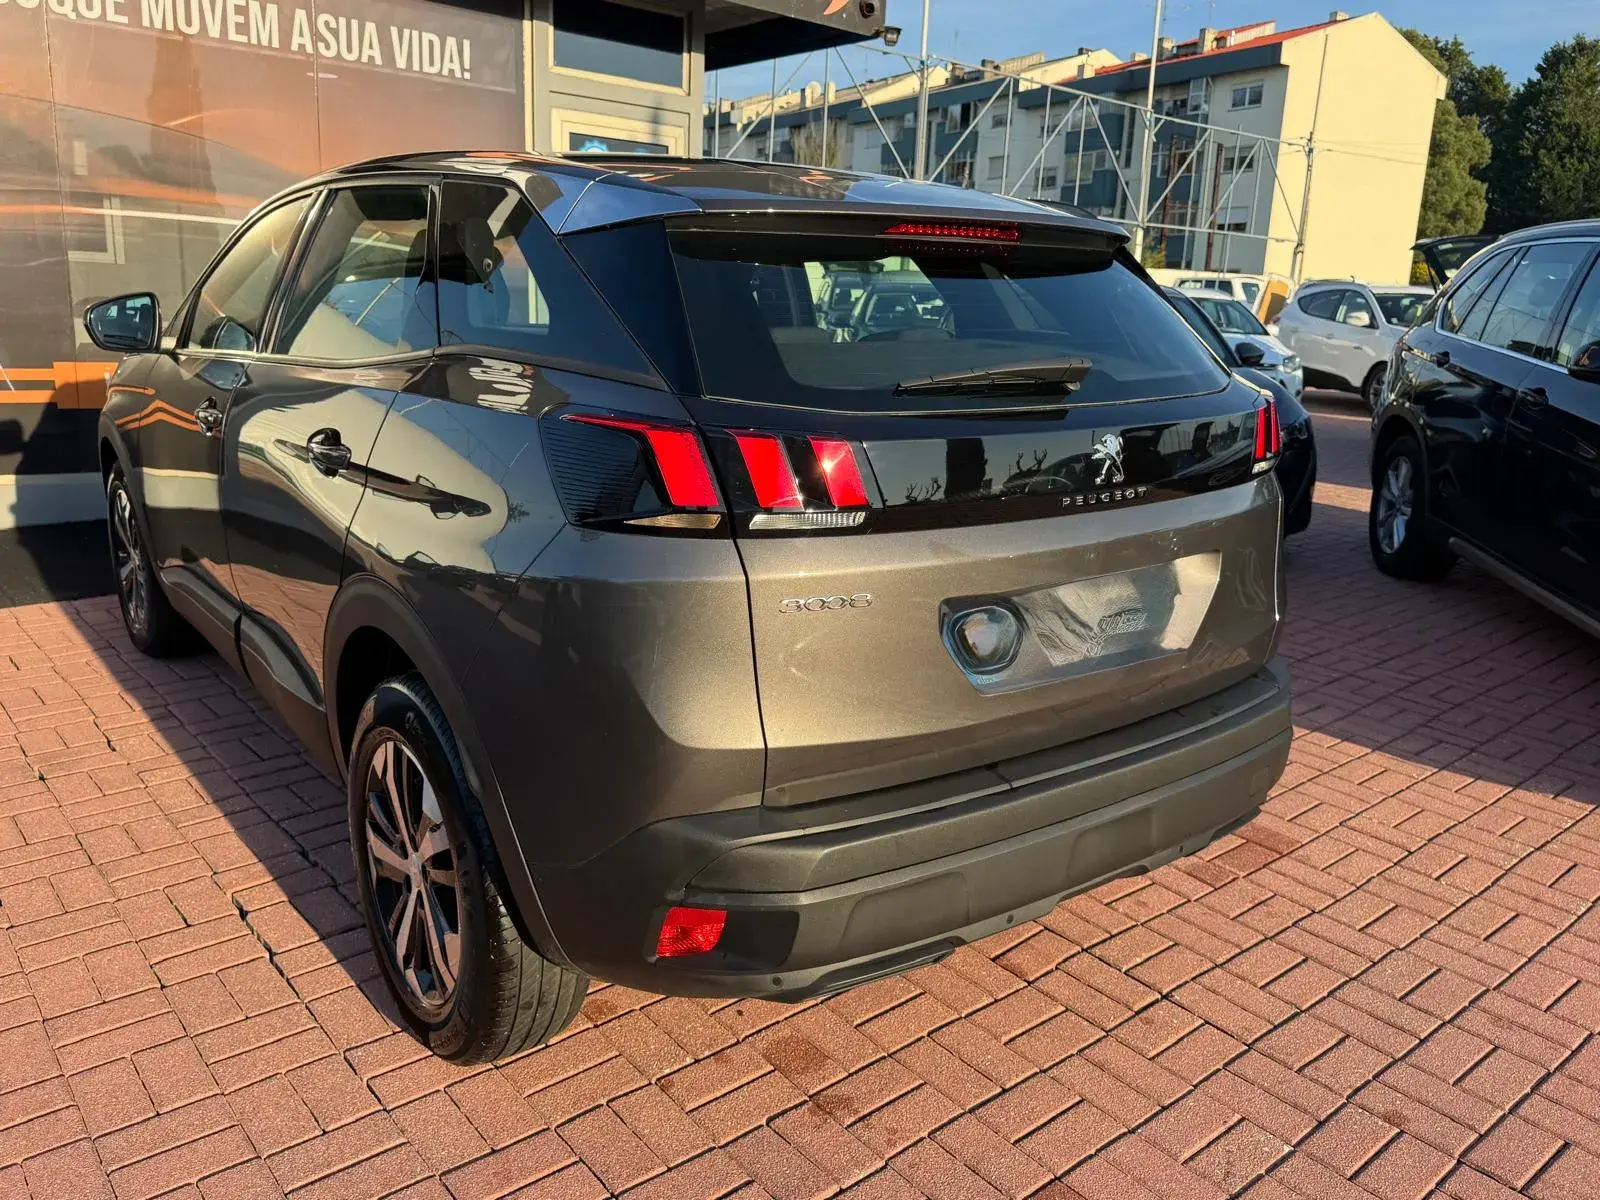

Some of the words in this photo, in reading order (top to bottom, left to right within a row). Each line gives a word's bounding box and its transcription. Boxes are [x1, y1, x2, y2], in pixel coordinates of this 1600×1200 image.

[140, 0, 280, 48] MOVEM
[390, 25, 471, 80] VIDA!
[1062, 486, 1148, 508] PEUGEOT
[778, 593, 873, 613] 3008
